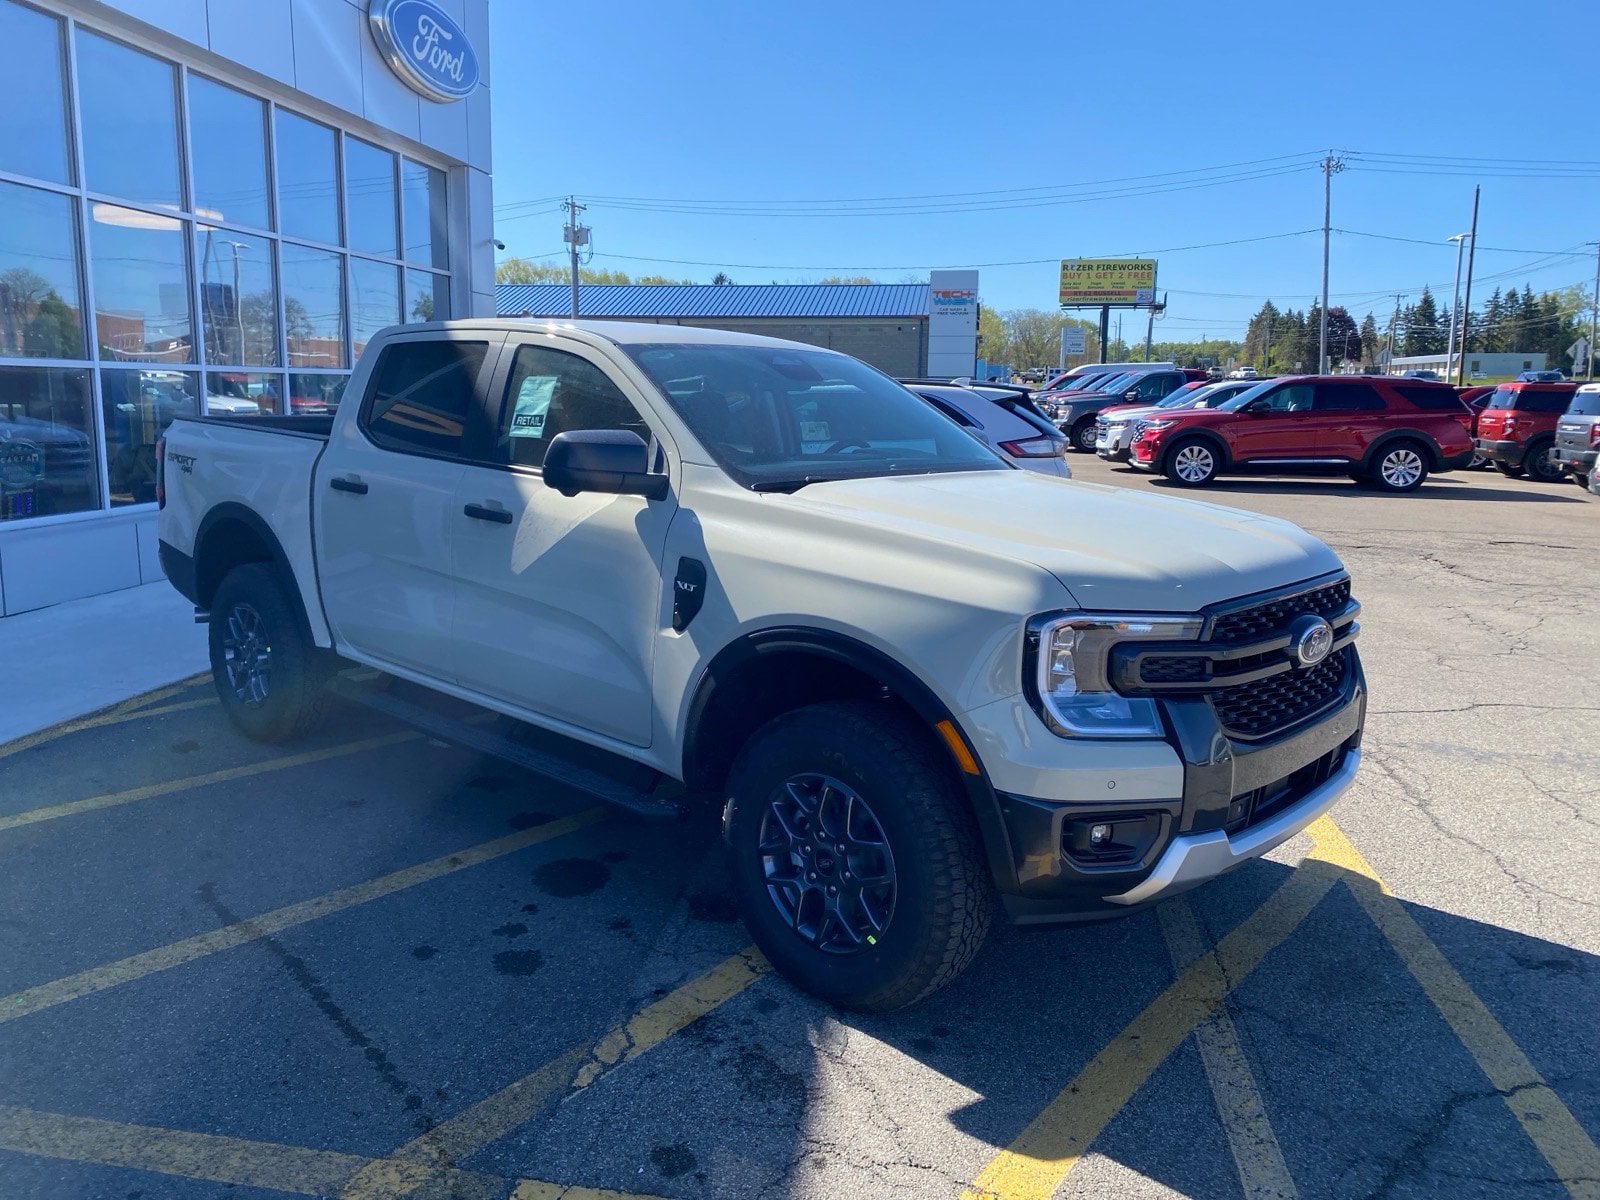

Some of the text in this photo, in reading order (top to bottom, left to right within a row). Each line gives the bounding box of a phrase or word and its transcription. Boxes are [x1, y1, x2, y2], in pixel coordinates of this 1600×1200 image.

[413, 14, 465, 82] Ford
[1062, 271, 1082, 280] BUY
[1095, 271, 1114, 279] GET
[1118, 271, 1124, 279] 2
[1127, 271, 1152, 279] FREE
[516, 416, 542, 426] RETAIL
[167, 452, 198, 467] SPORT
[676, 580, 698, 592] XLT
[1308, 633, 1328, 656] Ford
